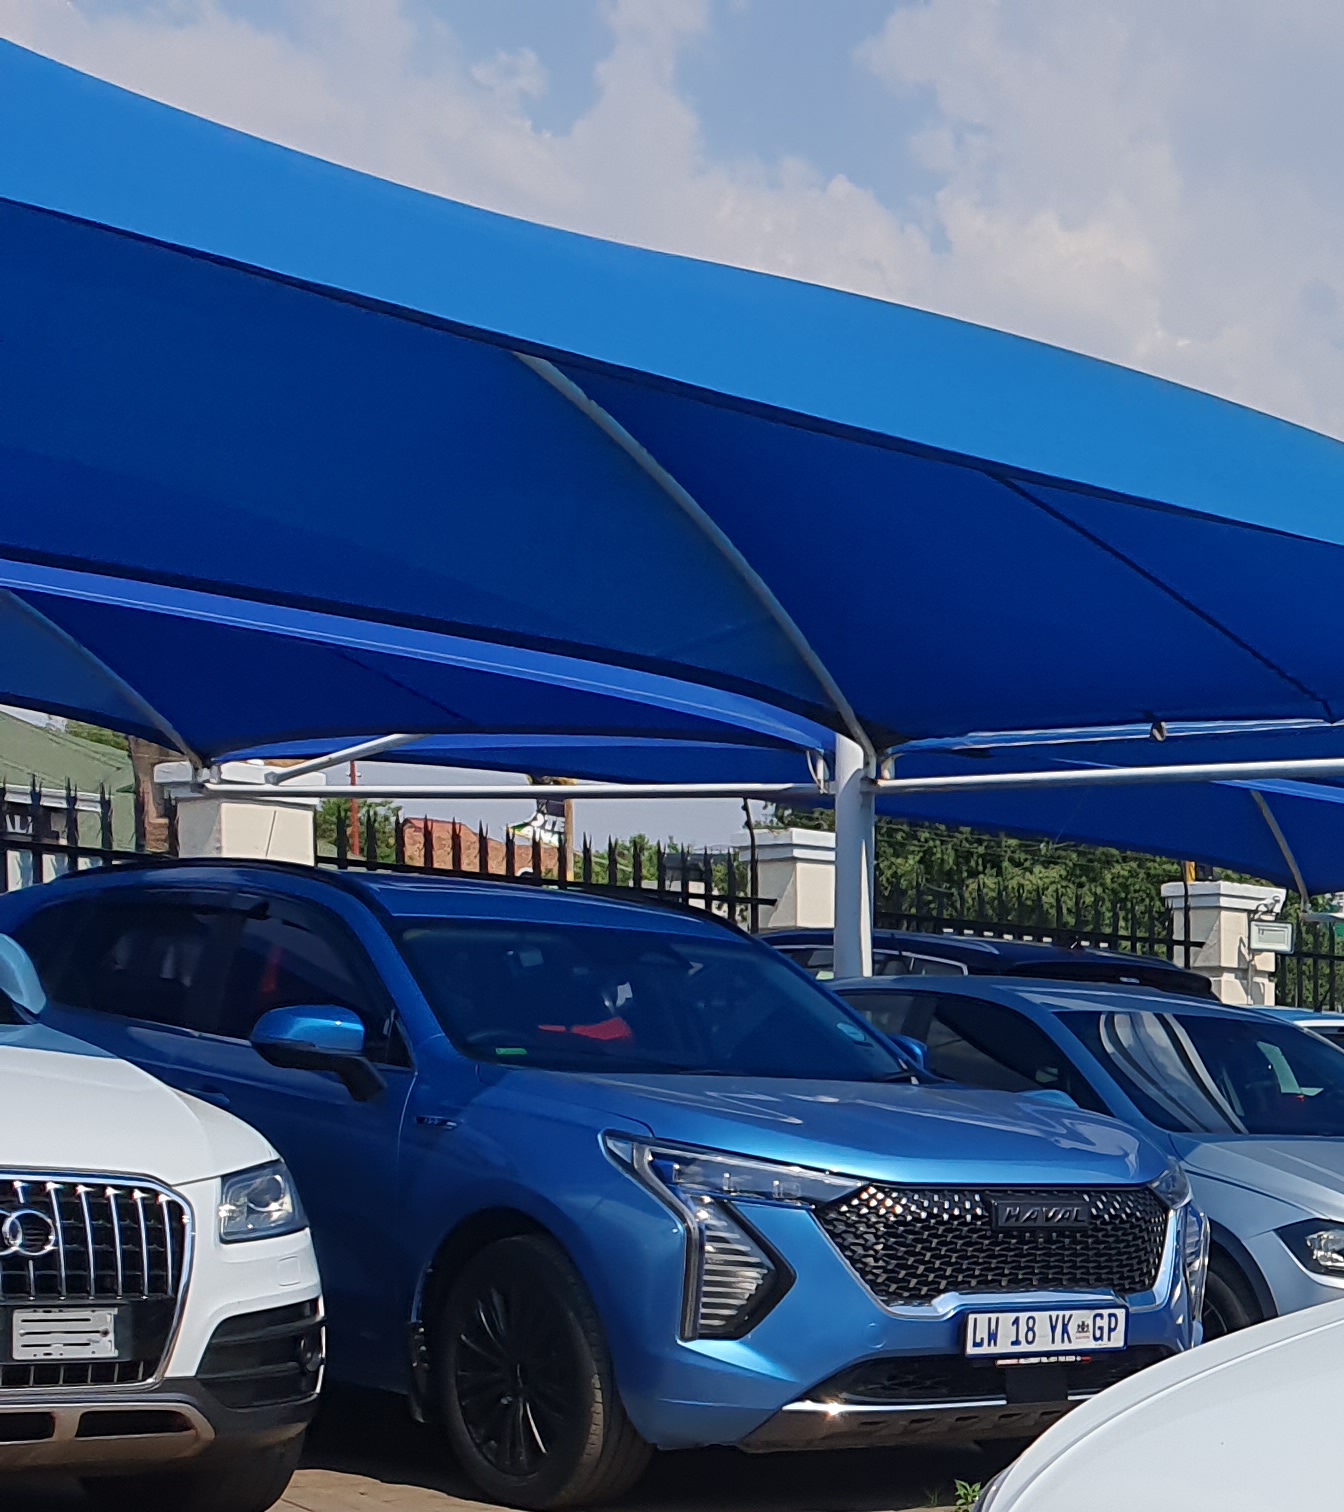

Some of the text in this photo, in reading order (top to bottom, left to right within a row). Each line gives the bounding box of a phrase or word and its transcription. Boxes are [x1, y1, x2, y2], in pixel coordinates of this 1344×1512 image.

[1002, 1206, 1088, 1223] HAVAL
[972, 1313, 1119, 1348] LW 18 YK GP
